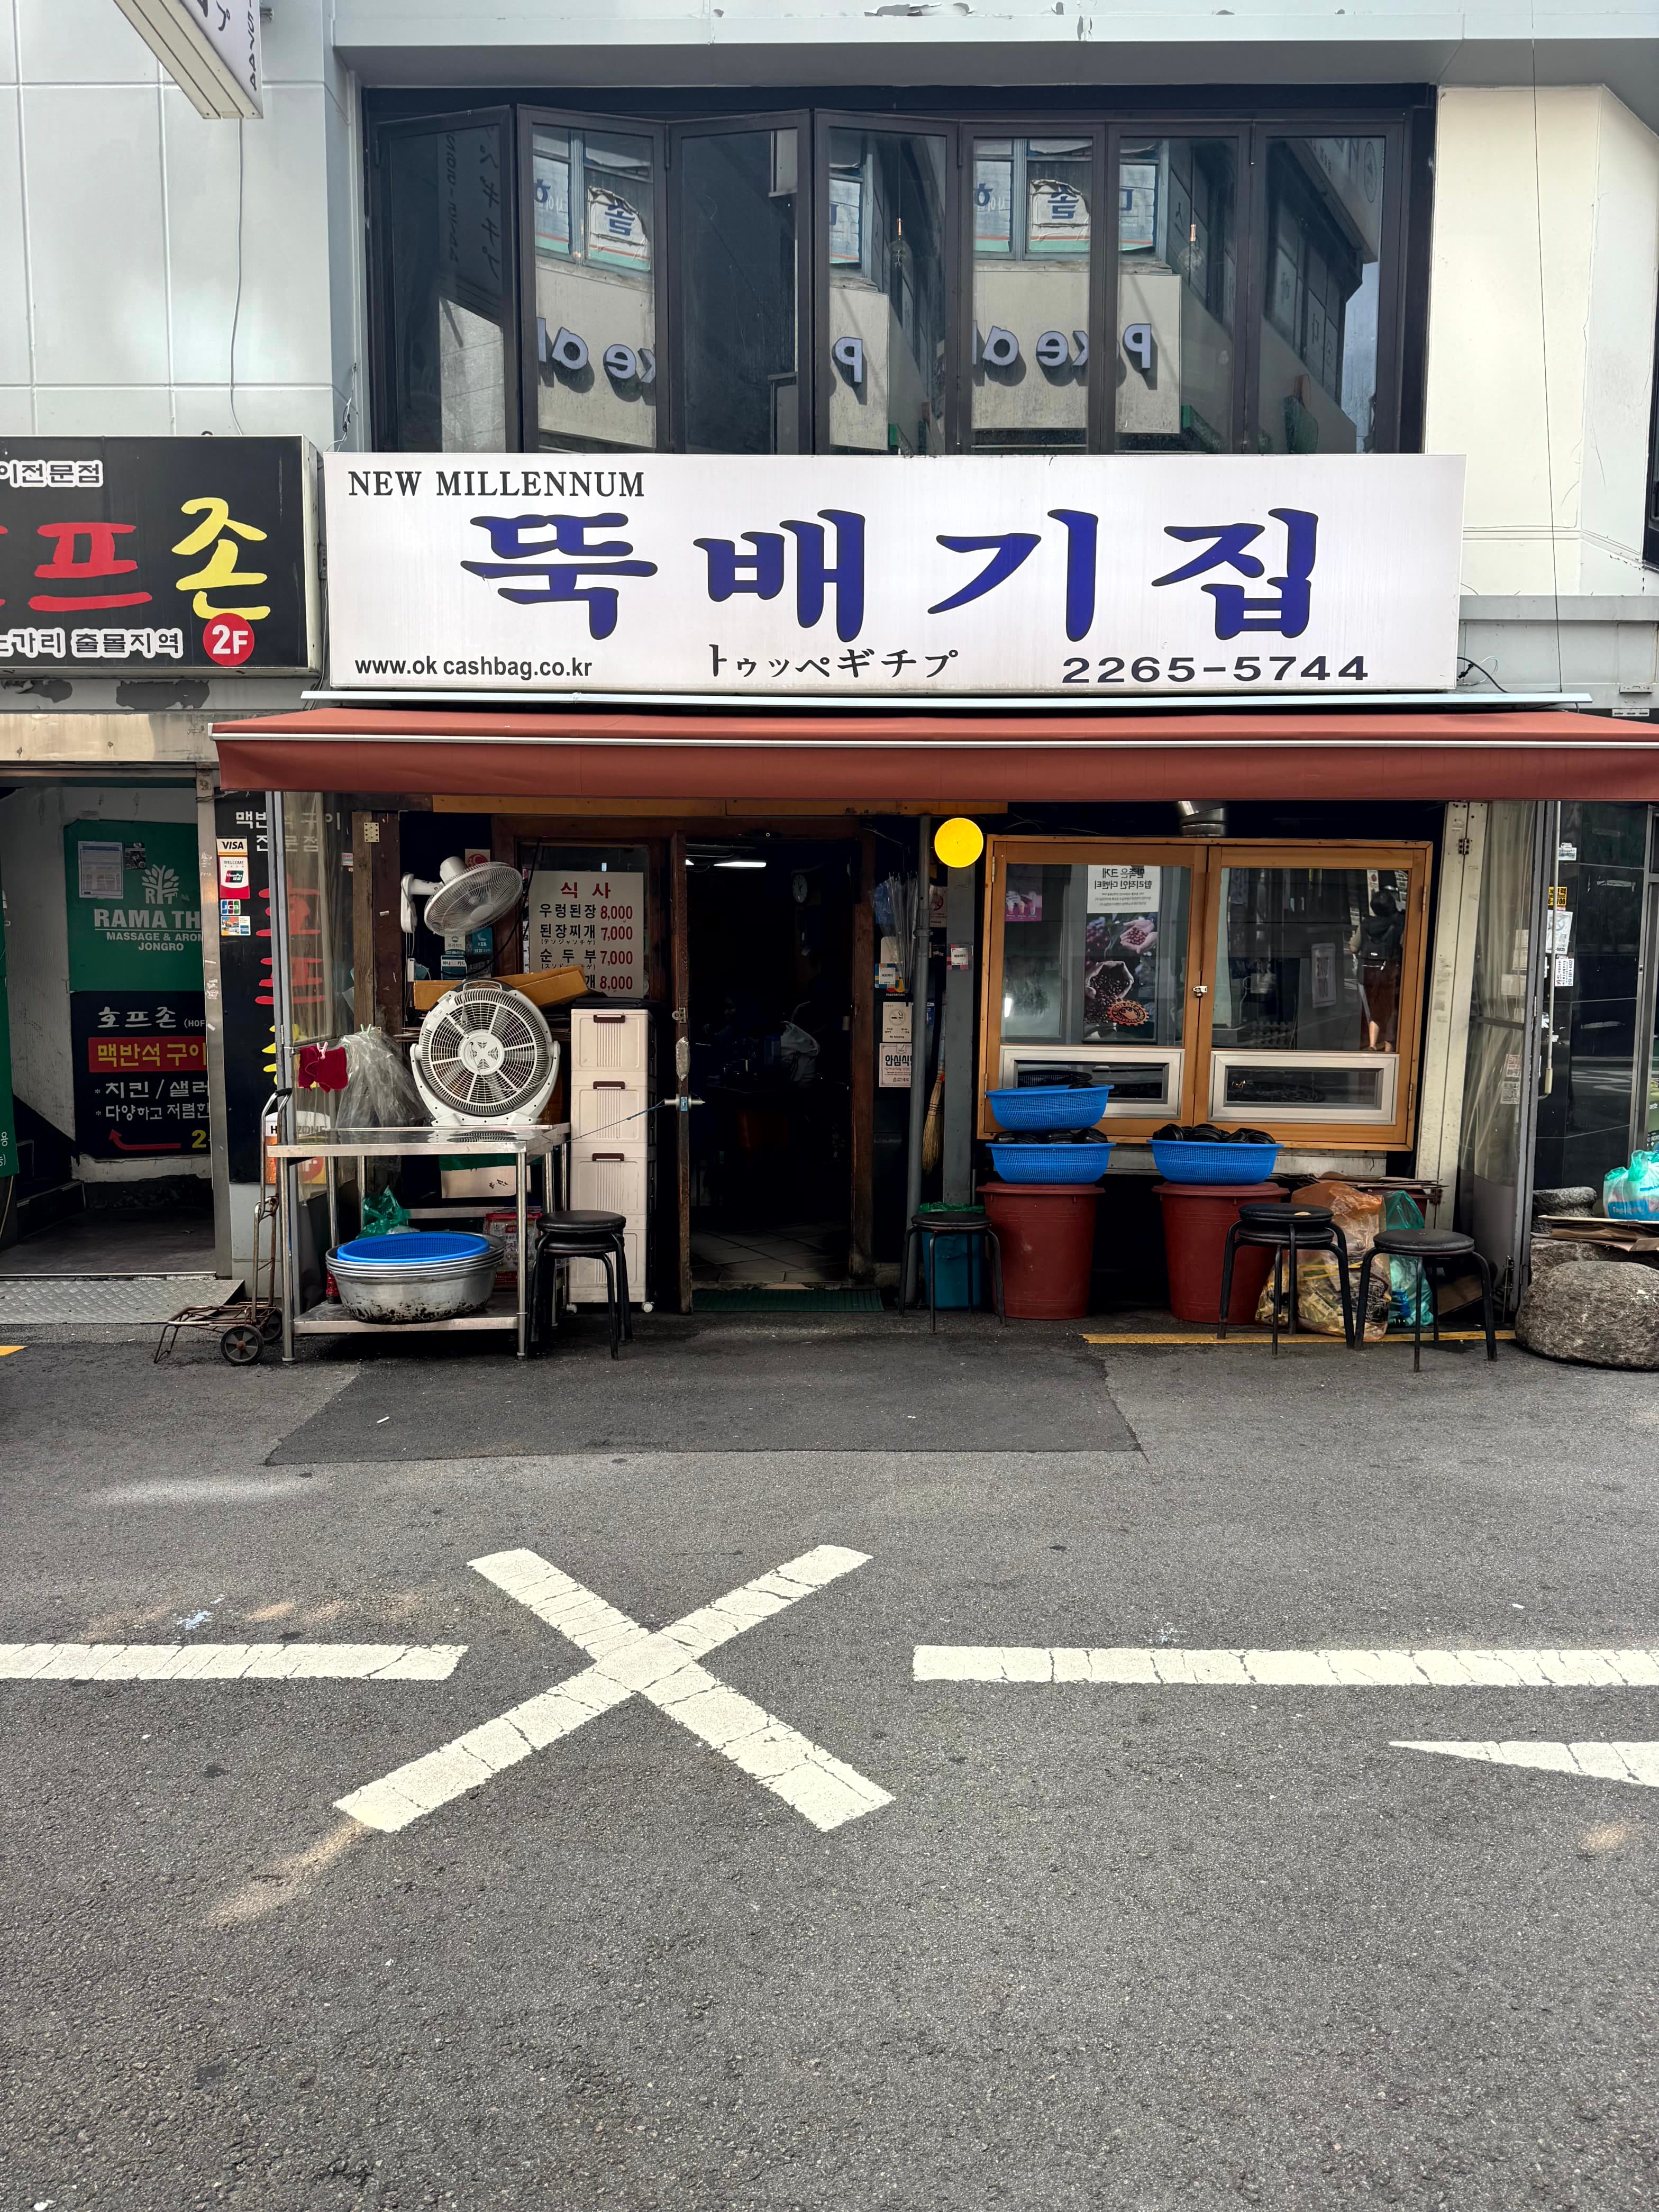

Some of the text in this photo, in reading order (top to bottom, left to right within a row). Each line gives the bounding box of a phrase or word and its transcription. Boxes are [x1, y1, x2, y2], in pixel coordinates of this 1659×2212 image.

[348, 471, 645, 497] NEW MILLENNUM
[0, 497, 271, 620] 프존
[460, 508, 1319, 642] 뚝배기집
[73, 630, 181, 657] 출몰지역
[212, 624, 249, 654] 2F
[1061, 655, 1369, 684] 2265-5744
[221, 841, 244, 850] VISA
[94, 908, 168, 929] RAMA
[539, 903, 633, 921] 우렁된장 8,000
[106, 931, 160, 941] MASSAGE
[163, 933, 171, 941] &
[540, 923, 596, 939] 된장찌개
[600, 926, 633, 941] 7,000
[138, 942, 184, 951] JONGRO
[600, 950, 633, 966] 7,000
[599, 976, 633, 990] 8,000
[97, 1006, 177, 1028] 호프존
[97, 1043, 161, 1067] 맥반석
[885, 1054, 912, 1067] 안심식
[105, 1081, 149, 1099] 치킨
[105, 1104, 163, 1122] 다양하고
